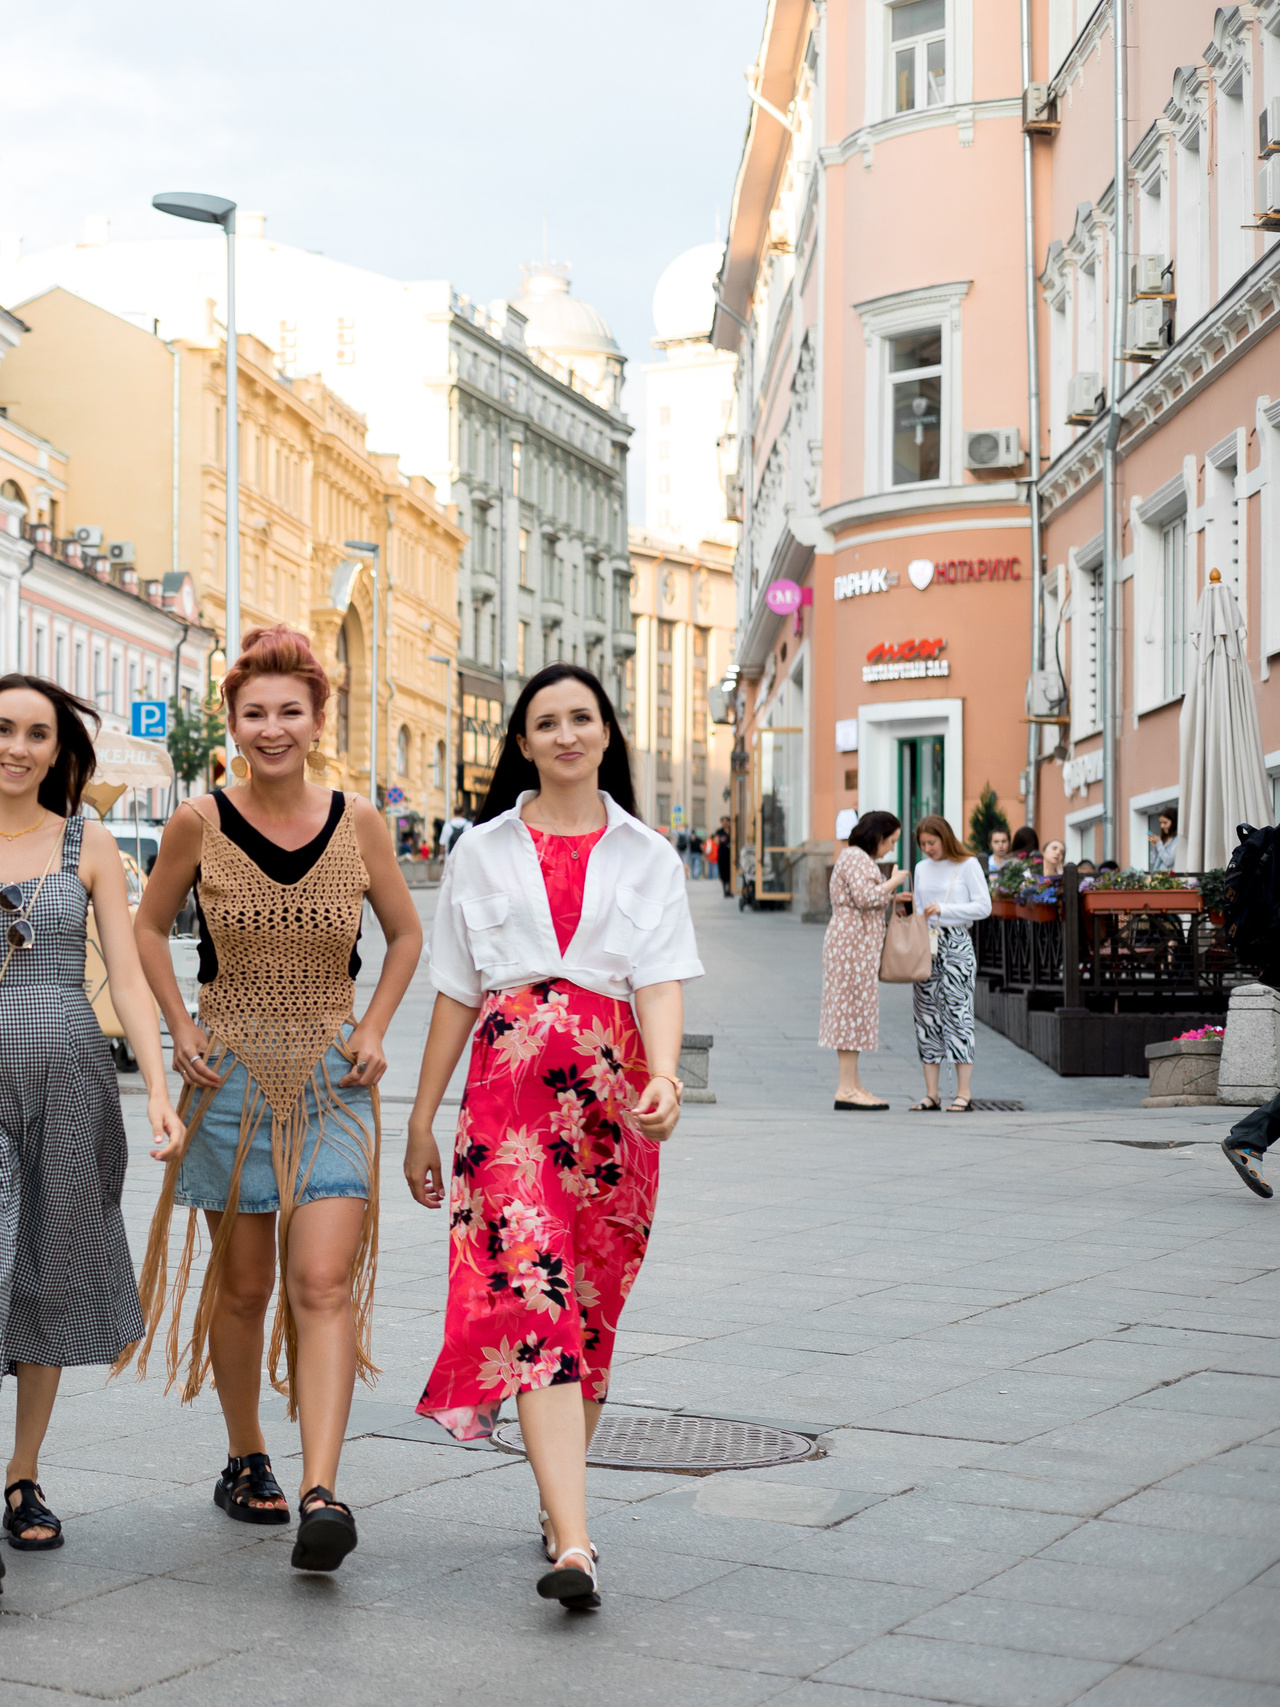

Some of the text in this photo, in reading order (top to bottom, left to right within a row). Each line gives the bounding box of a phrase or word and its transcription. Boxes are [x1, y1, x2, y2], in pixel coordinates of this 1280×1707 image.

[834, 567, 888, 601] ПАРНИК
[935, 557, 1020, 584] НОТАРИУС
[141, 704, 161, 734] P
